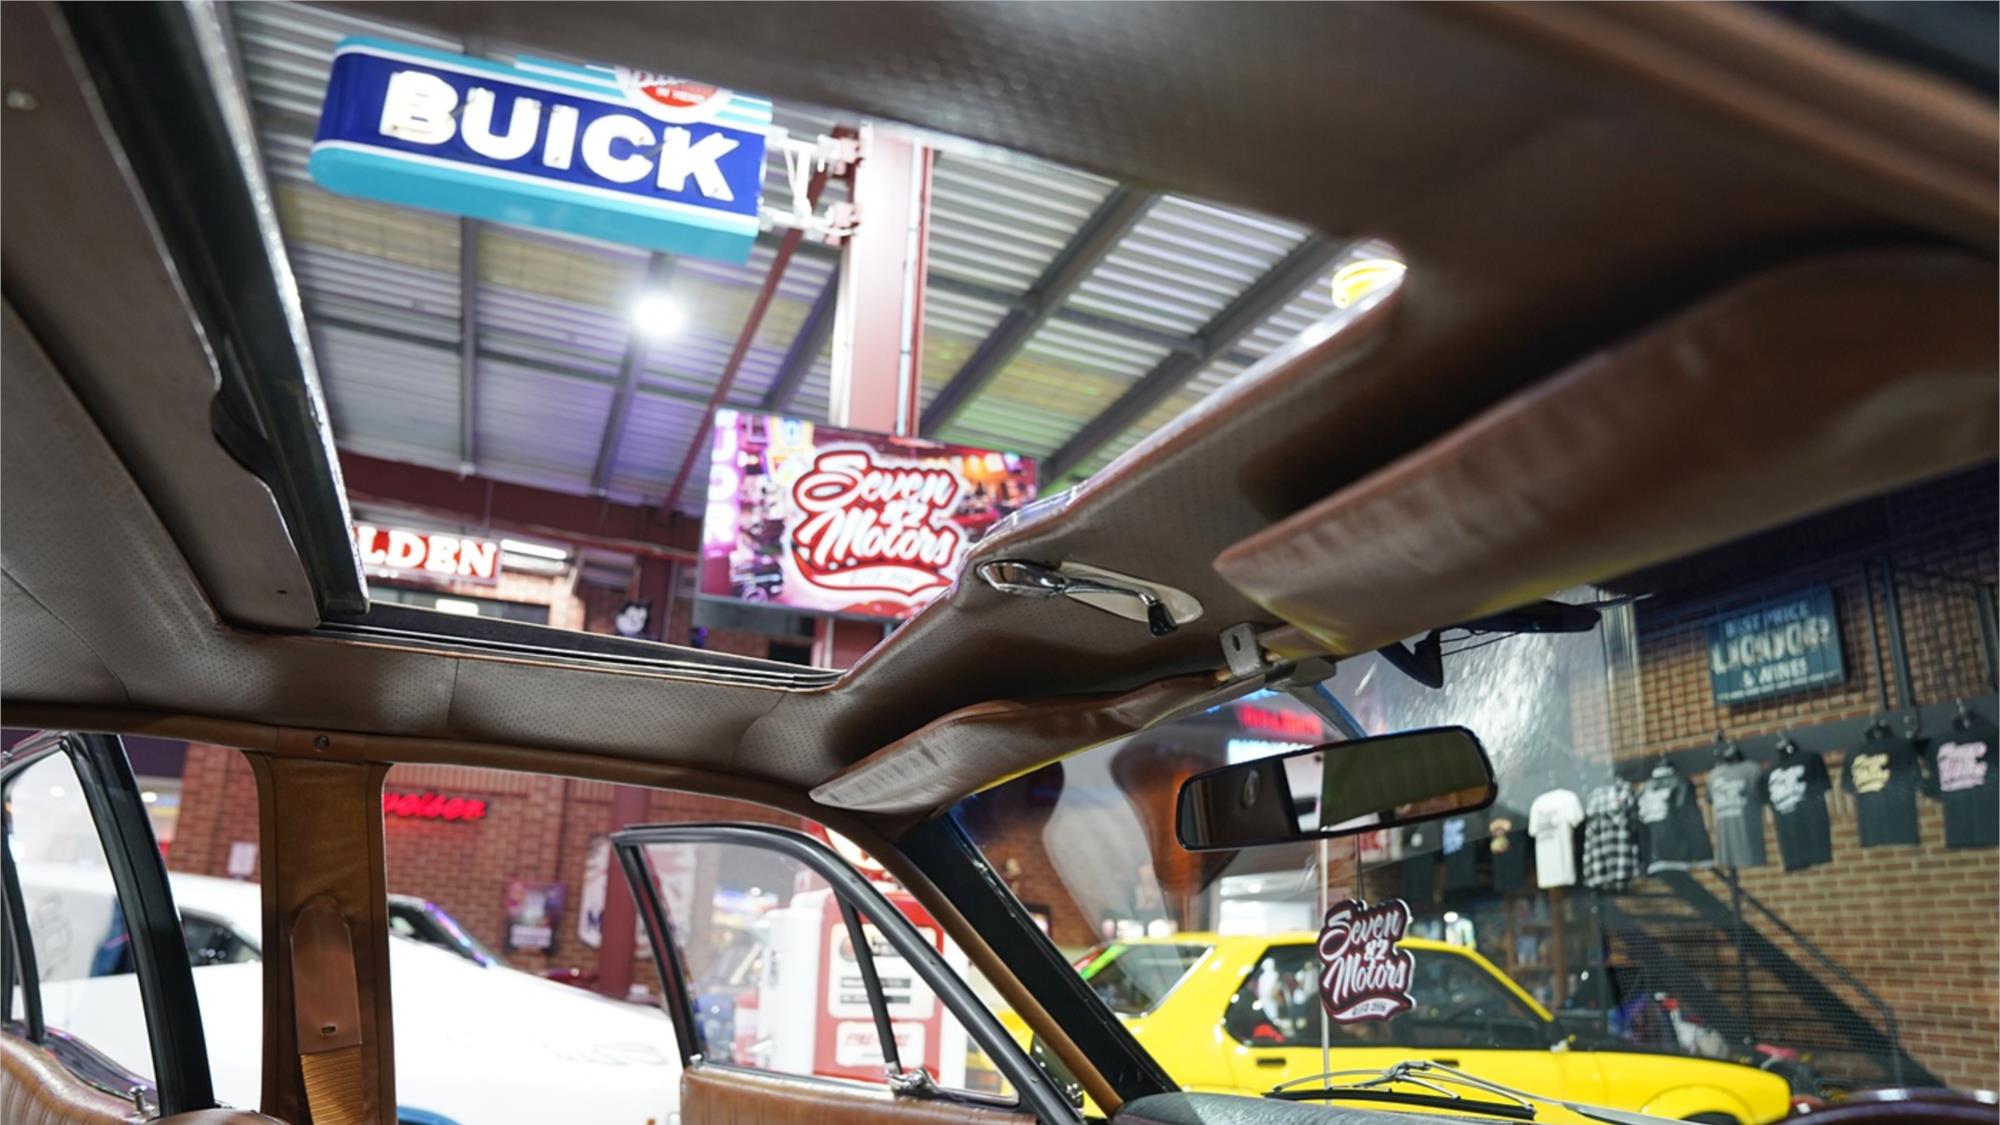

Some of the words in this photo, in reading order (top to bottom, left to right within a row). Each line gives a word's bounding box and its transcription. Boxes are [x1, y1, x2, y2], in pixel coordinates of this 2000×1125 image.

[379, 70, 739, 200] BUICK
[797, 452, 952, 512] Seven
[797, 507, 955, 566] Motors
[1320, 910, 1400, 960] Seven
[1323, 953, 1407, 1004] Motors
